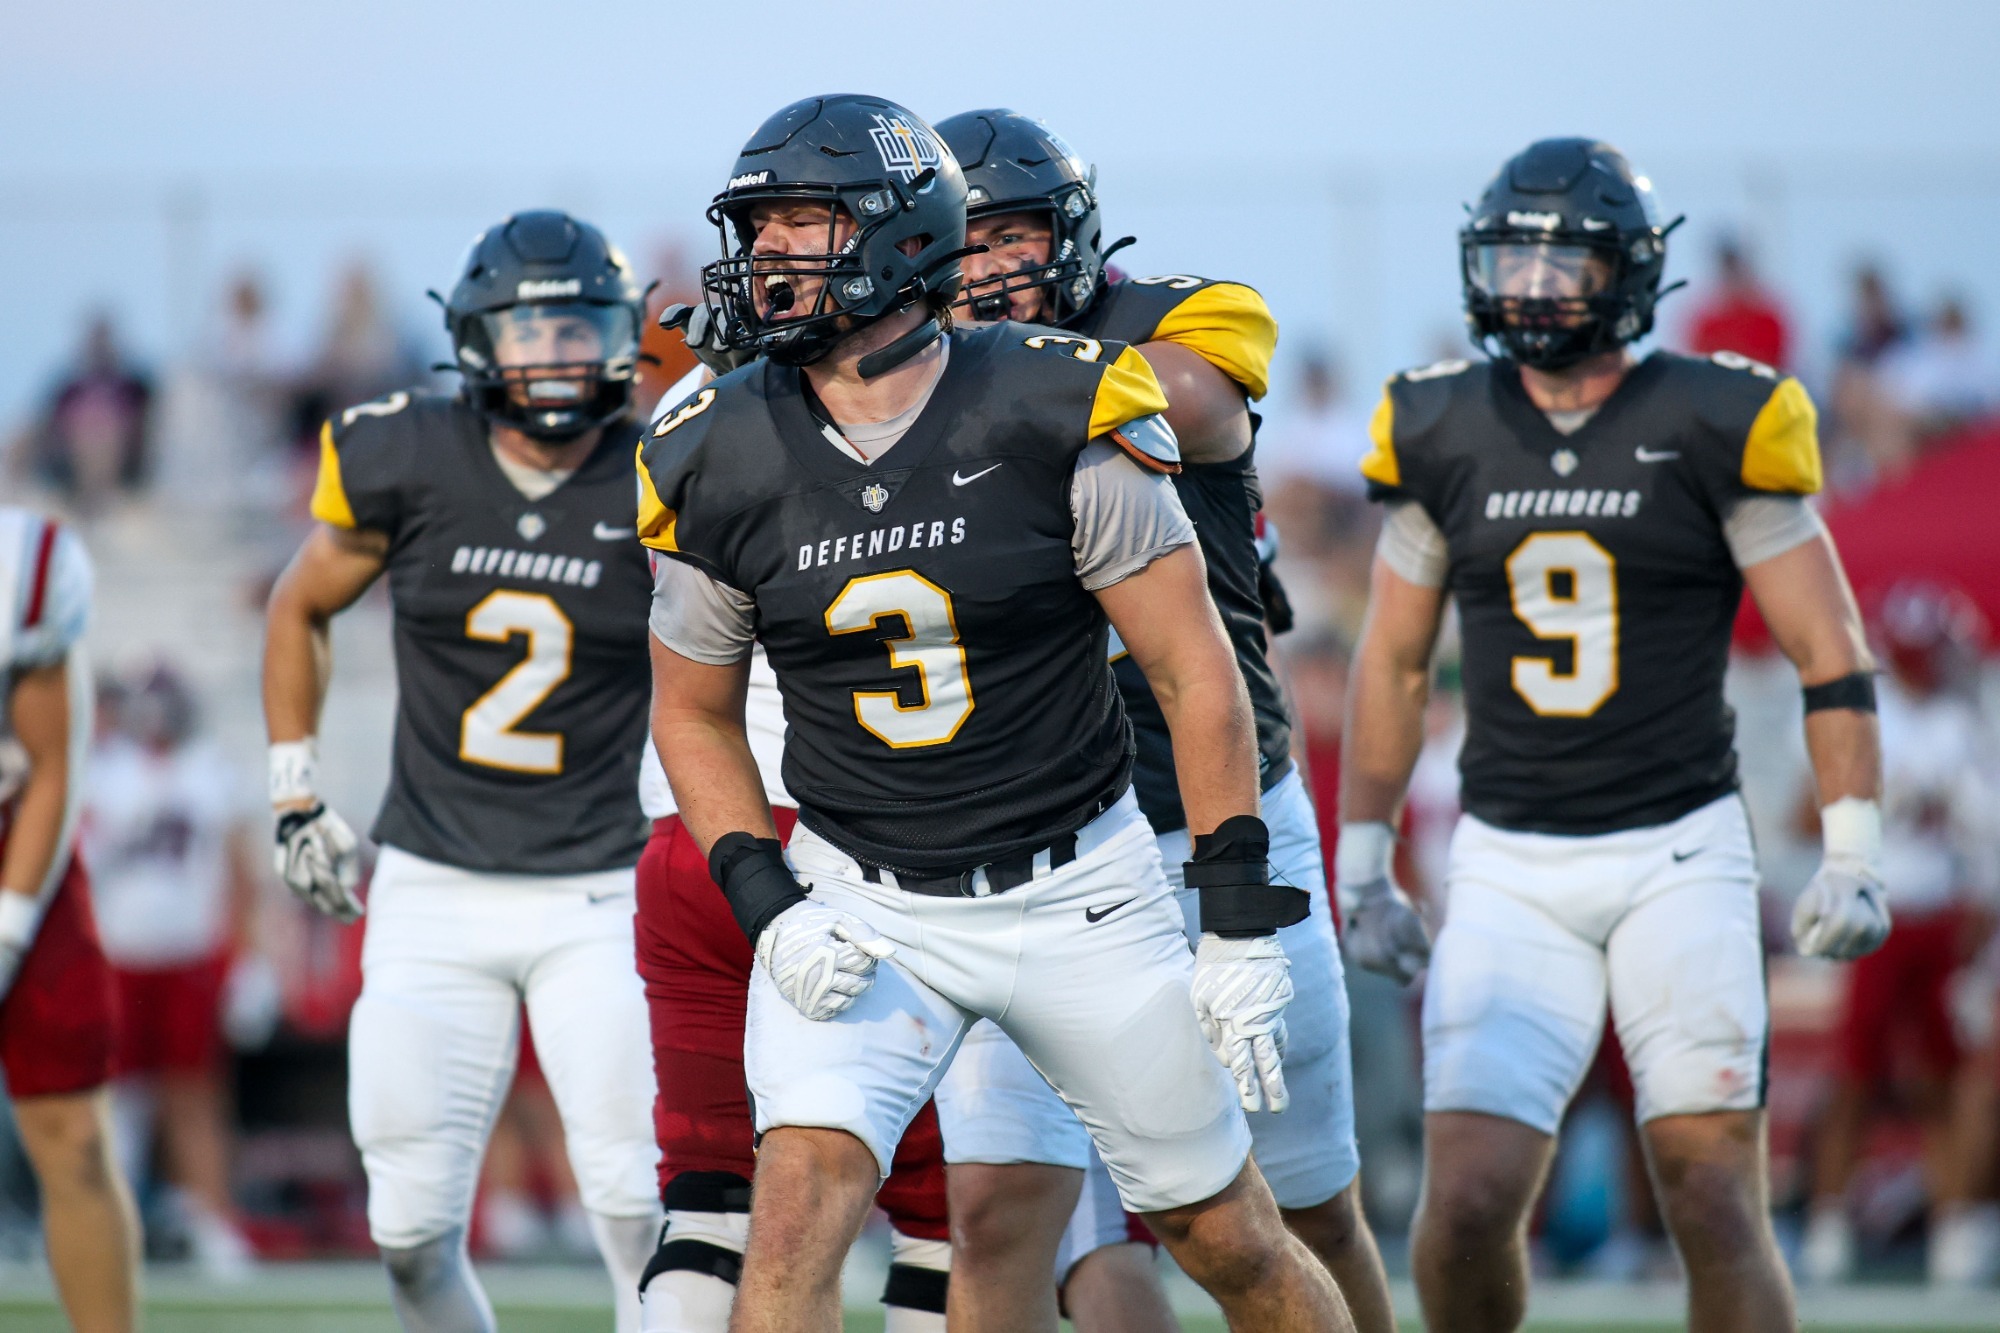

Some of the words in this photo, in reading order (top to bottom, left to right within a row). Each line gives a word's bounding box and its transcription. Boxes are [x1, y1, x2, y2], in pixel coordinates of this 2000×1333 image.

[1024, 334, 1103, 363] 3
[652, 388, 717, 437] 3
[1485, 490, 1641, 519] DEFENDERS
[451, 546, 602, 588] DEFENDERS
[797, 516, 967, 571] DEFENDERS
[1504, 530, 1620, 718] 9
[459, 588, 575, 774] 2
[823, 568, 976, 750] 3
